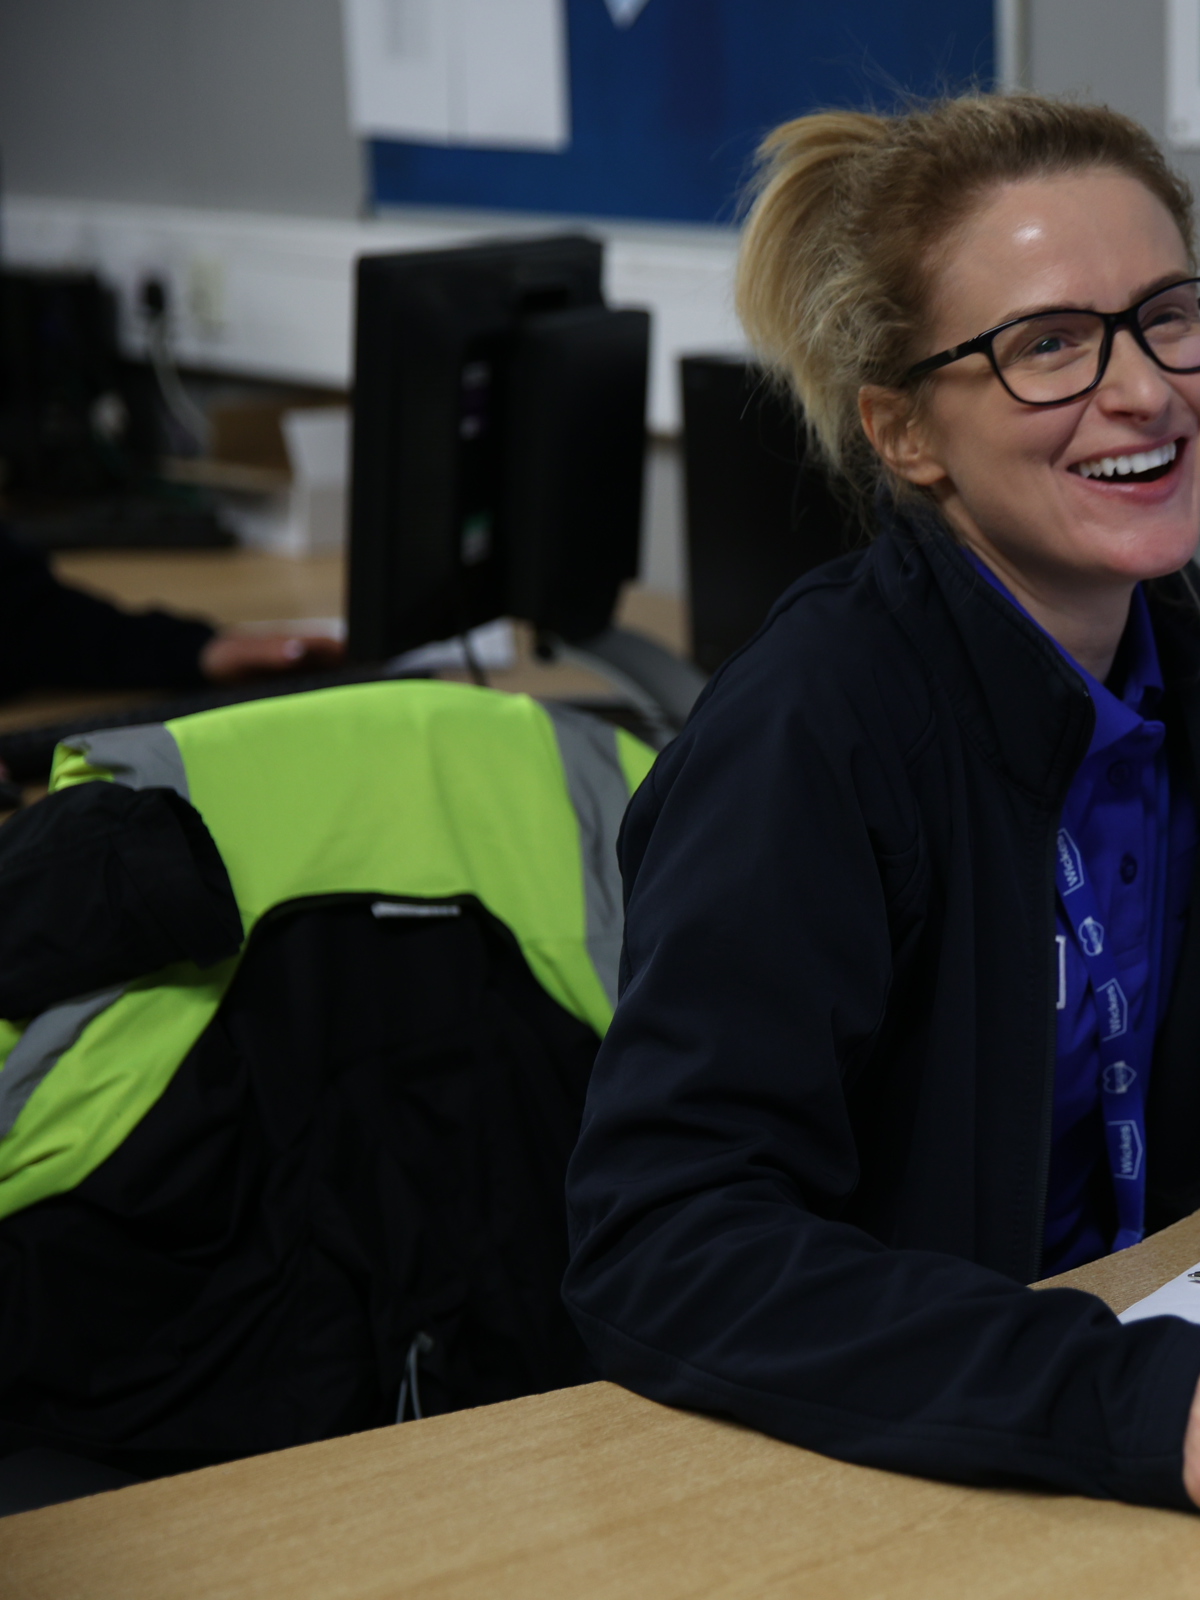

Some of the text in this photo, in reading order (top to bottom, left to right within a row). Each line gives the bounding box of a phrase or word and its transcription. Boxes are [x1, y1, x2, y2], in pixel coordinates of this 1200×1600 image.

[1057, 834, 1078, 887] Wickes
[1107, 984, 1121, 1034] Wickes
[1119, 1124, 1133, 1174] Wickes
